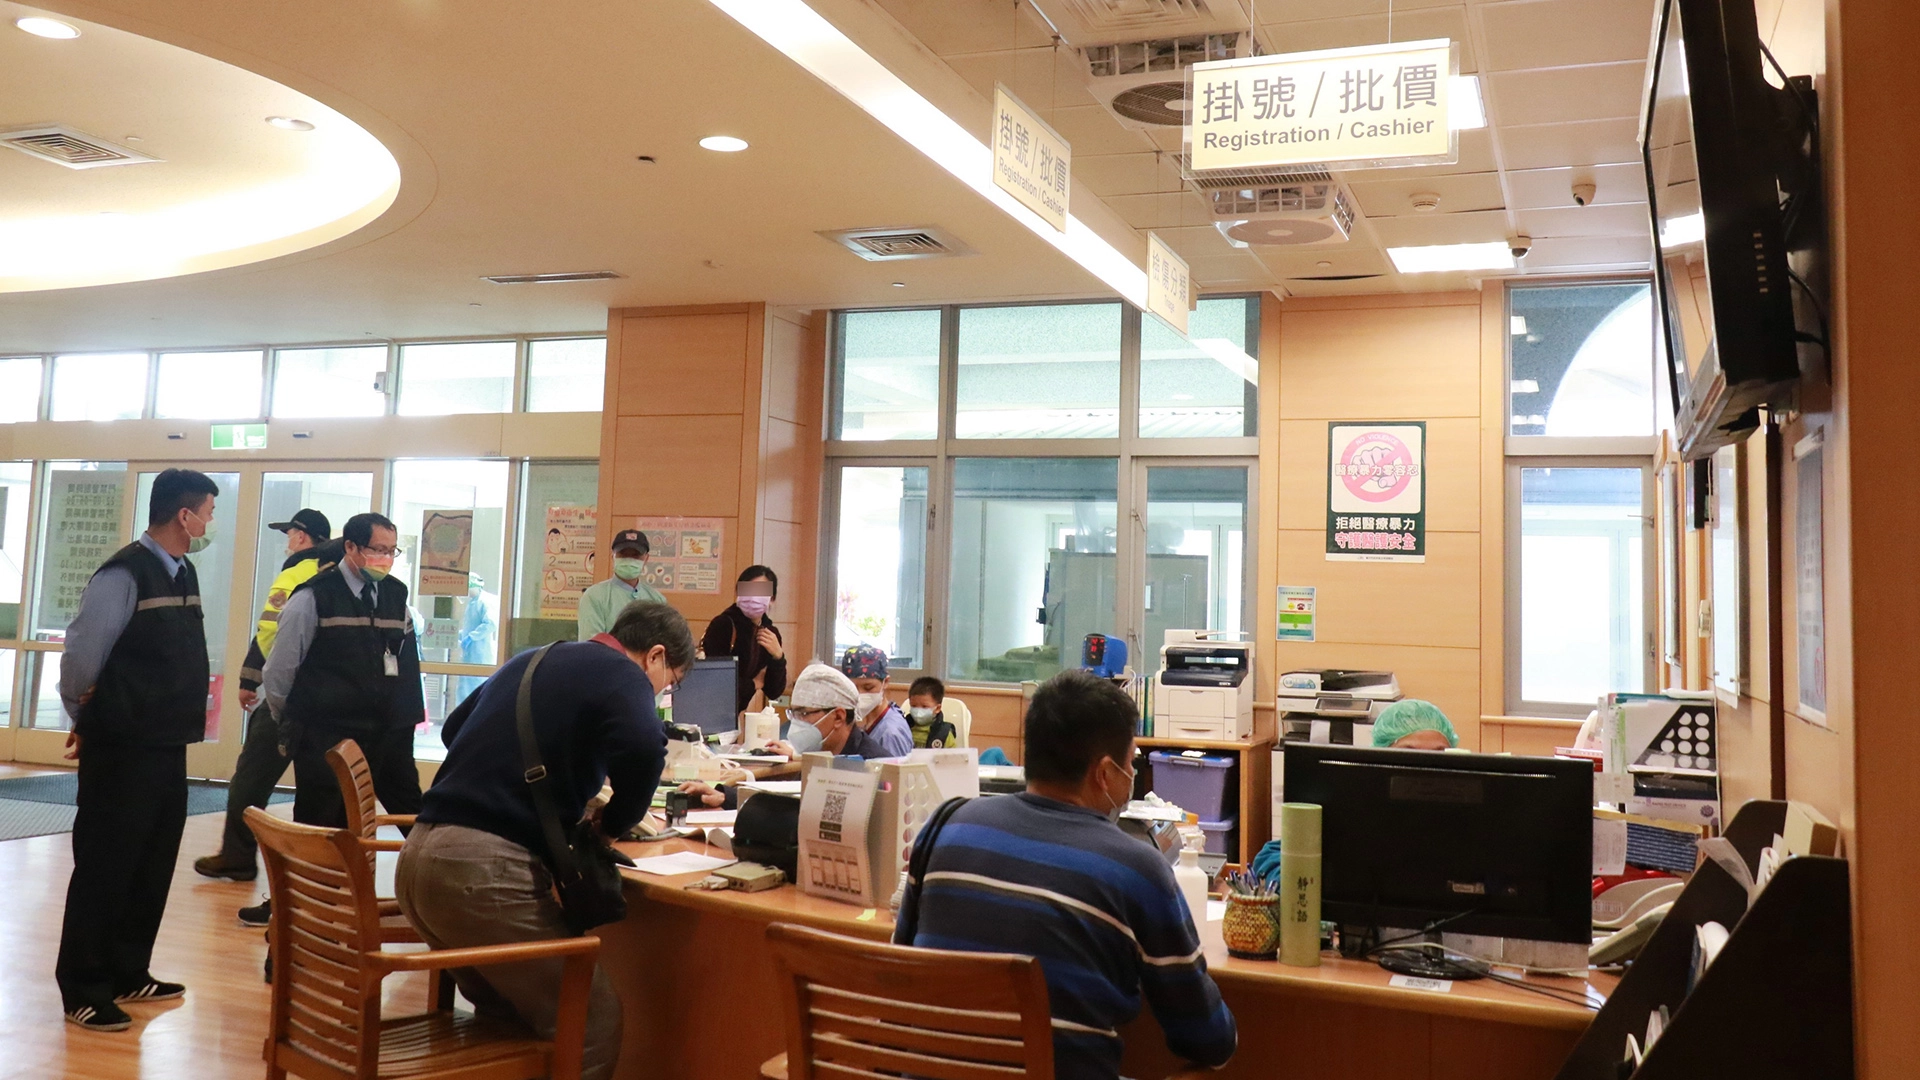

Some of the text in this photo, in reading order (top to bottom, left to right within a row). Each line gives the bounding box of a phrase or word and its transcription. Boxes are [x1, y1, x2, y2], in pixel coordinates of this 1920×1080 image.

[1202, 64, 1437, 124] 掛號 / 批價
[1203, 118, 1434, 151] Registration / Cashier
[999, 108, 1067, 198] 掛號 / 批價
[998, 156, 1038, 198] Registration
[1041, 191, 1065, 218] Cashier
[1152, 249, 1187, 305] 檢傷分類
[1355, 432, 1399, 447] NO VIOLENCE
[1335, 463, 1419, 477] 醫療暴力零容忍
[1335, 516, 1416, 531] 拒絕醫療暴力
[1335, 531, 1417, 551] 守護醫護安全
[549, 556, 556, 567] 2
[567, 576, 575, 587] 3
[543, 594, 550, 605] 4
[1297, 876, 1308, 922] 靜思語
